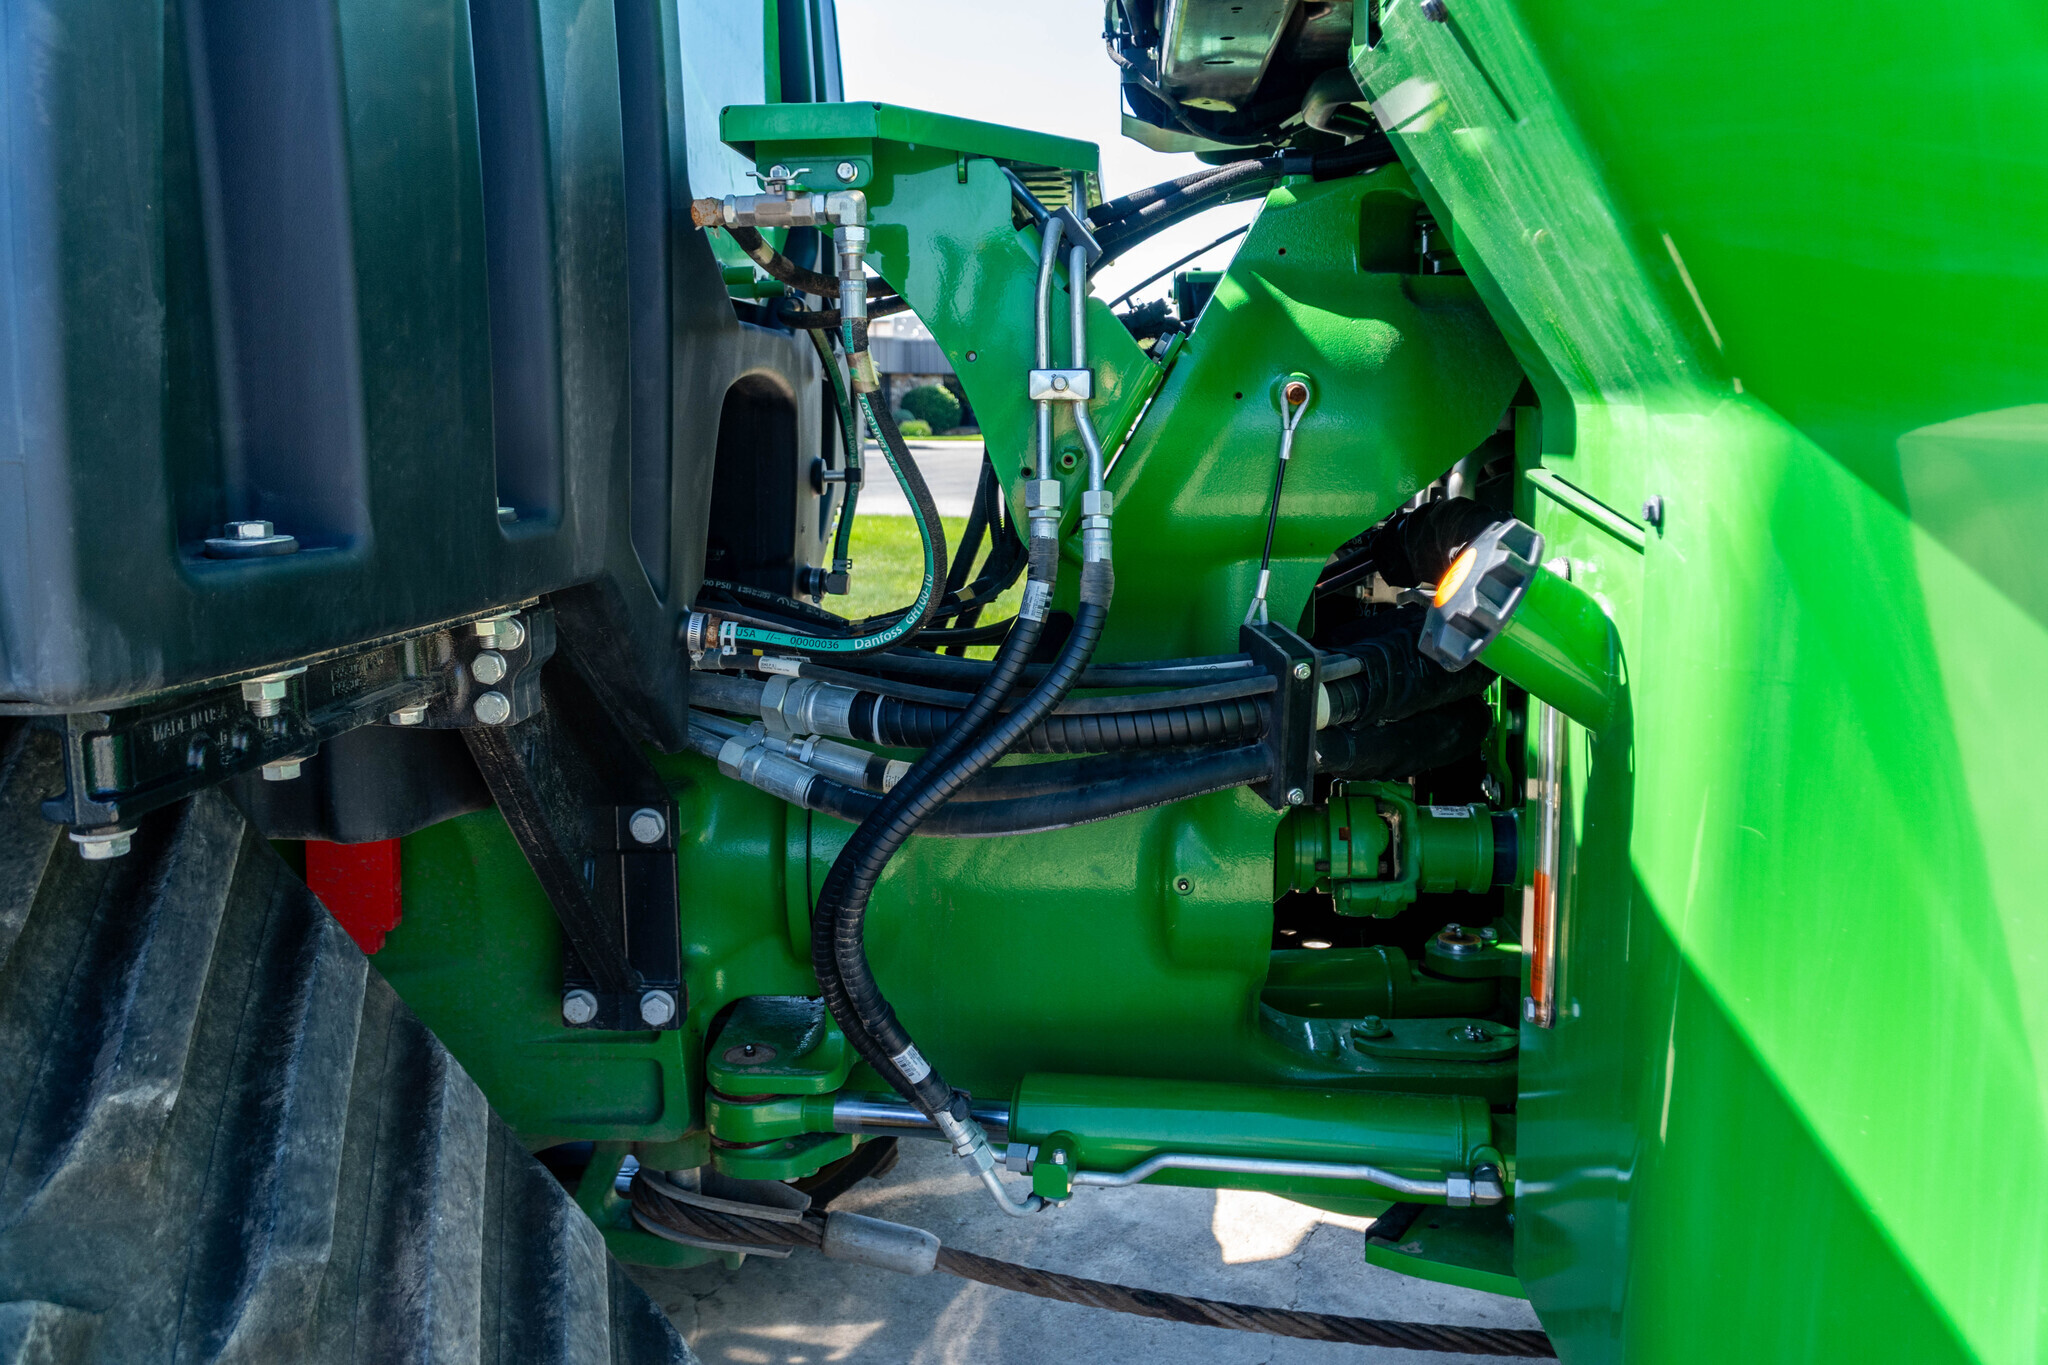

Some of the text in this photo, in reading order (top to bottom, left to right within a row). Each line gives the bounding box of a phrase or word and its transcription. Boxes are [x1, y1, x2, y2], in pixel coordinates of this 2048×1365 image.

[736, 628, 756, 638] USA
[789, 636, 840, 649] 00000036
[854, 625, 903, 650] Danfoss
[905, 573, 933, 625] GH100-10
